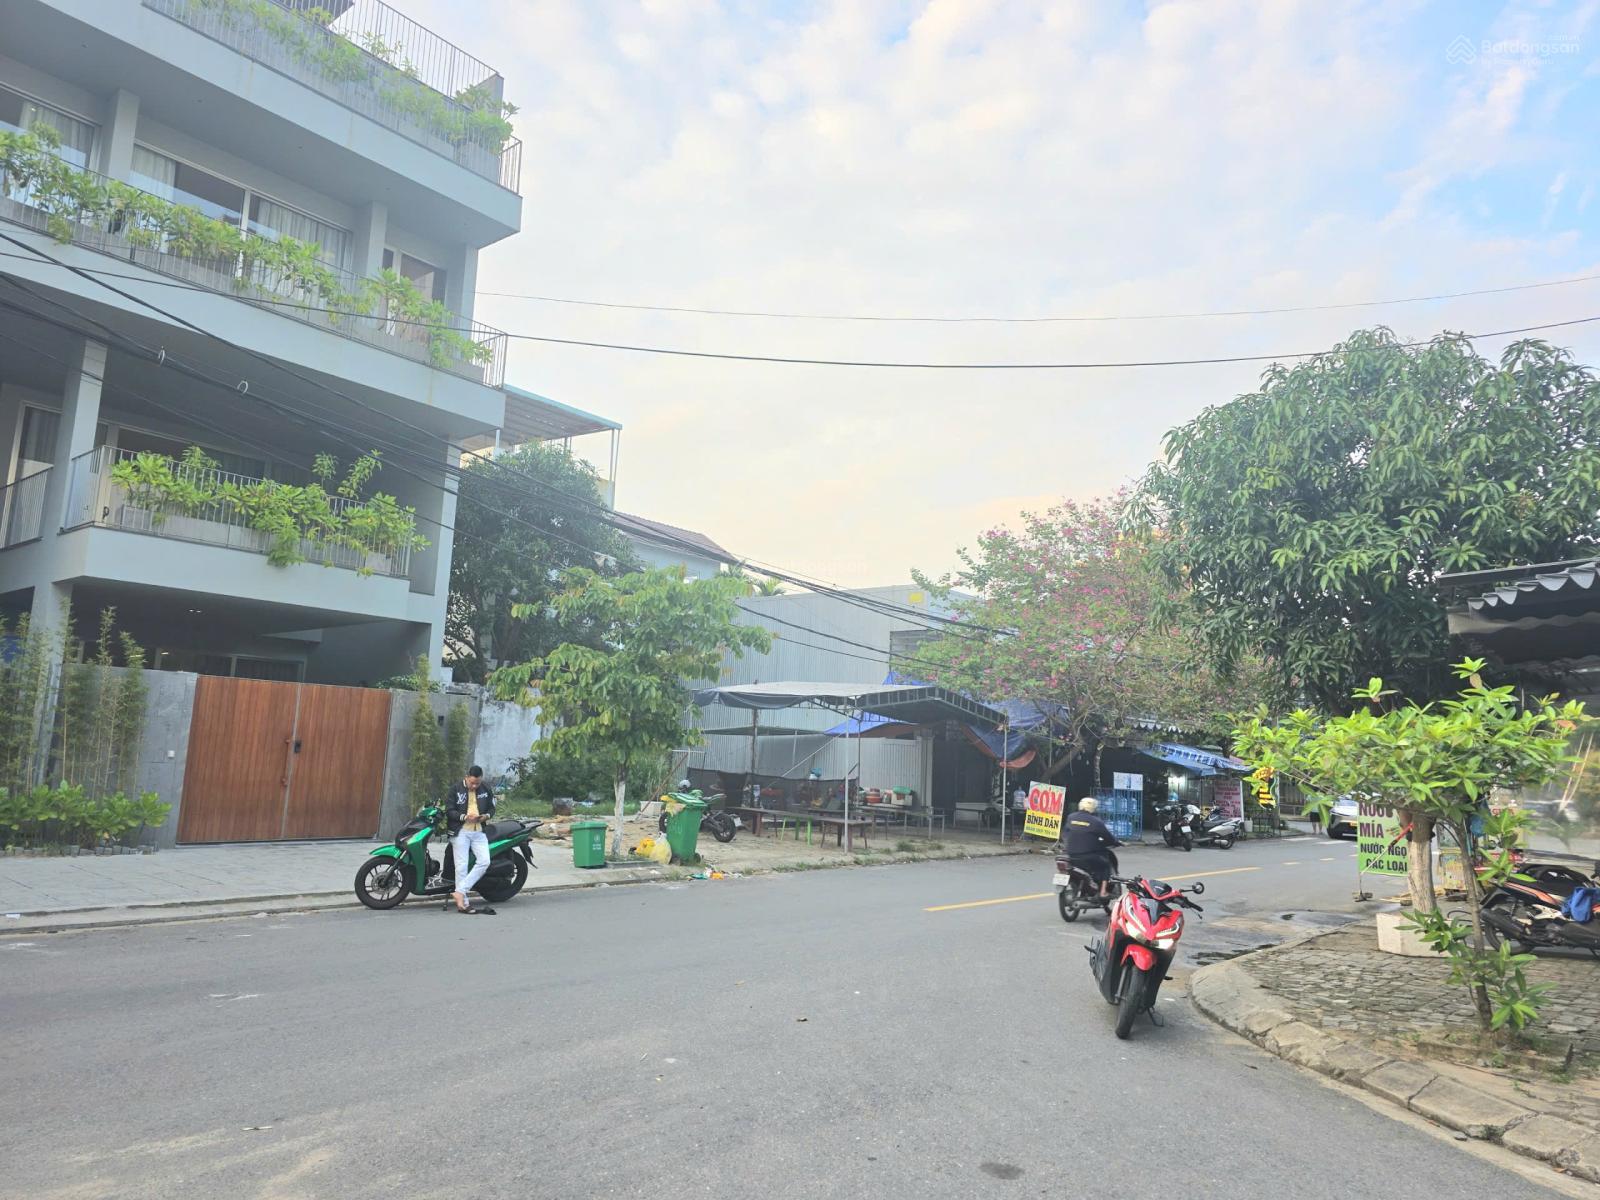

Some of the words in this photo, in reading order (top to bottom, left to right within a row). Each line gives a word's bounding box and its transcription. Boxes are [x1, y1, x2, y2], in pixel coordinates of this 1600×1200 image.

[1027, 813, 1043, 826] BÌNH
[1360, 820, 1385, 838] MÍA
[1366, 857, 1384, 870] CÁC
[1387, 860, 1407, 873] LOẠI
